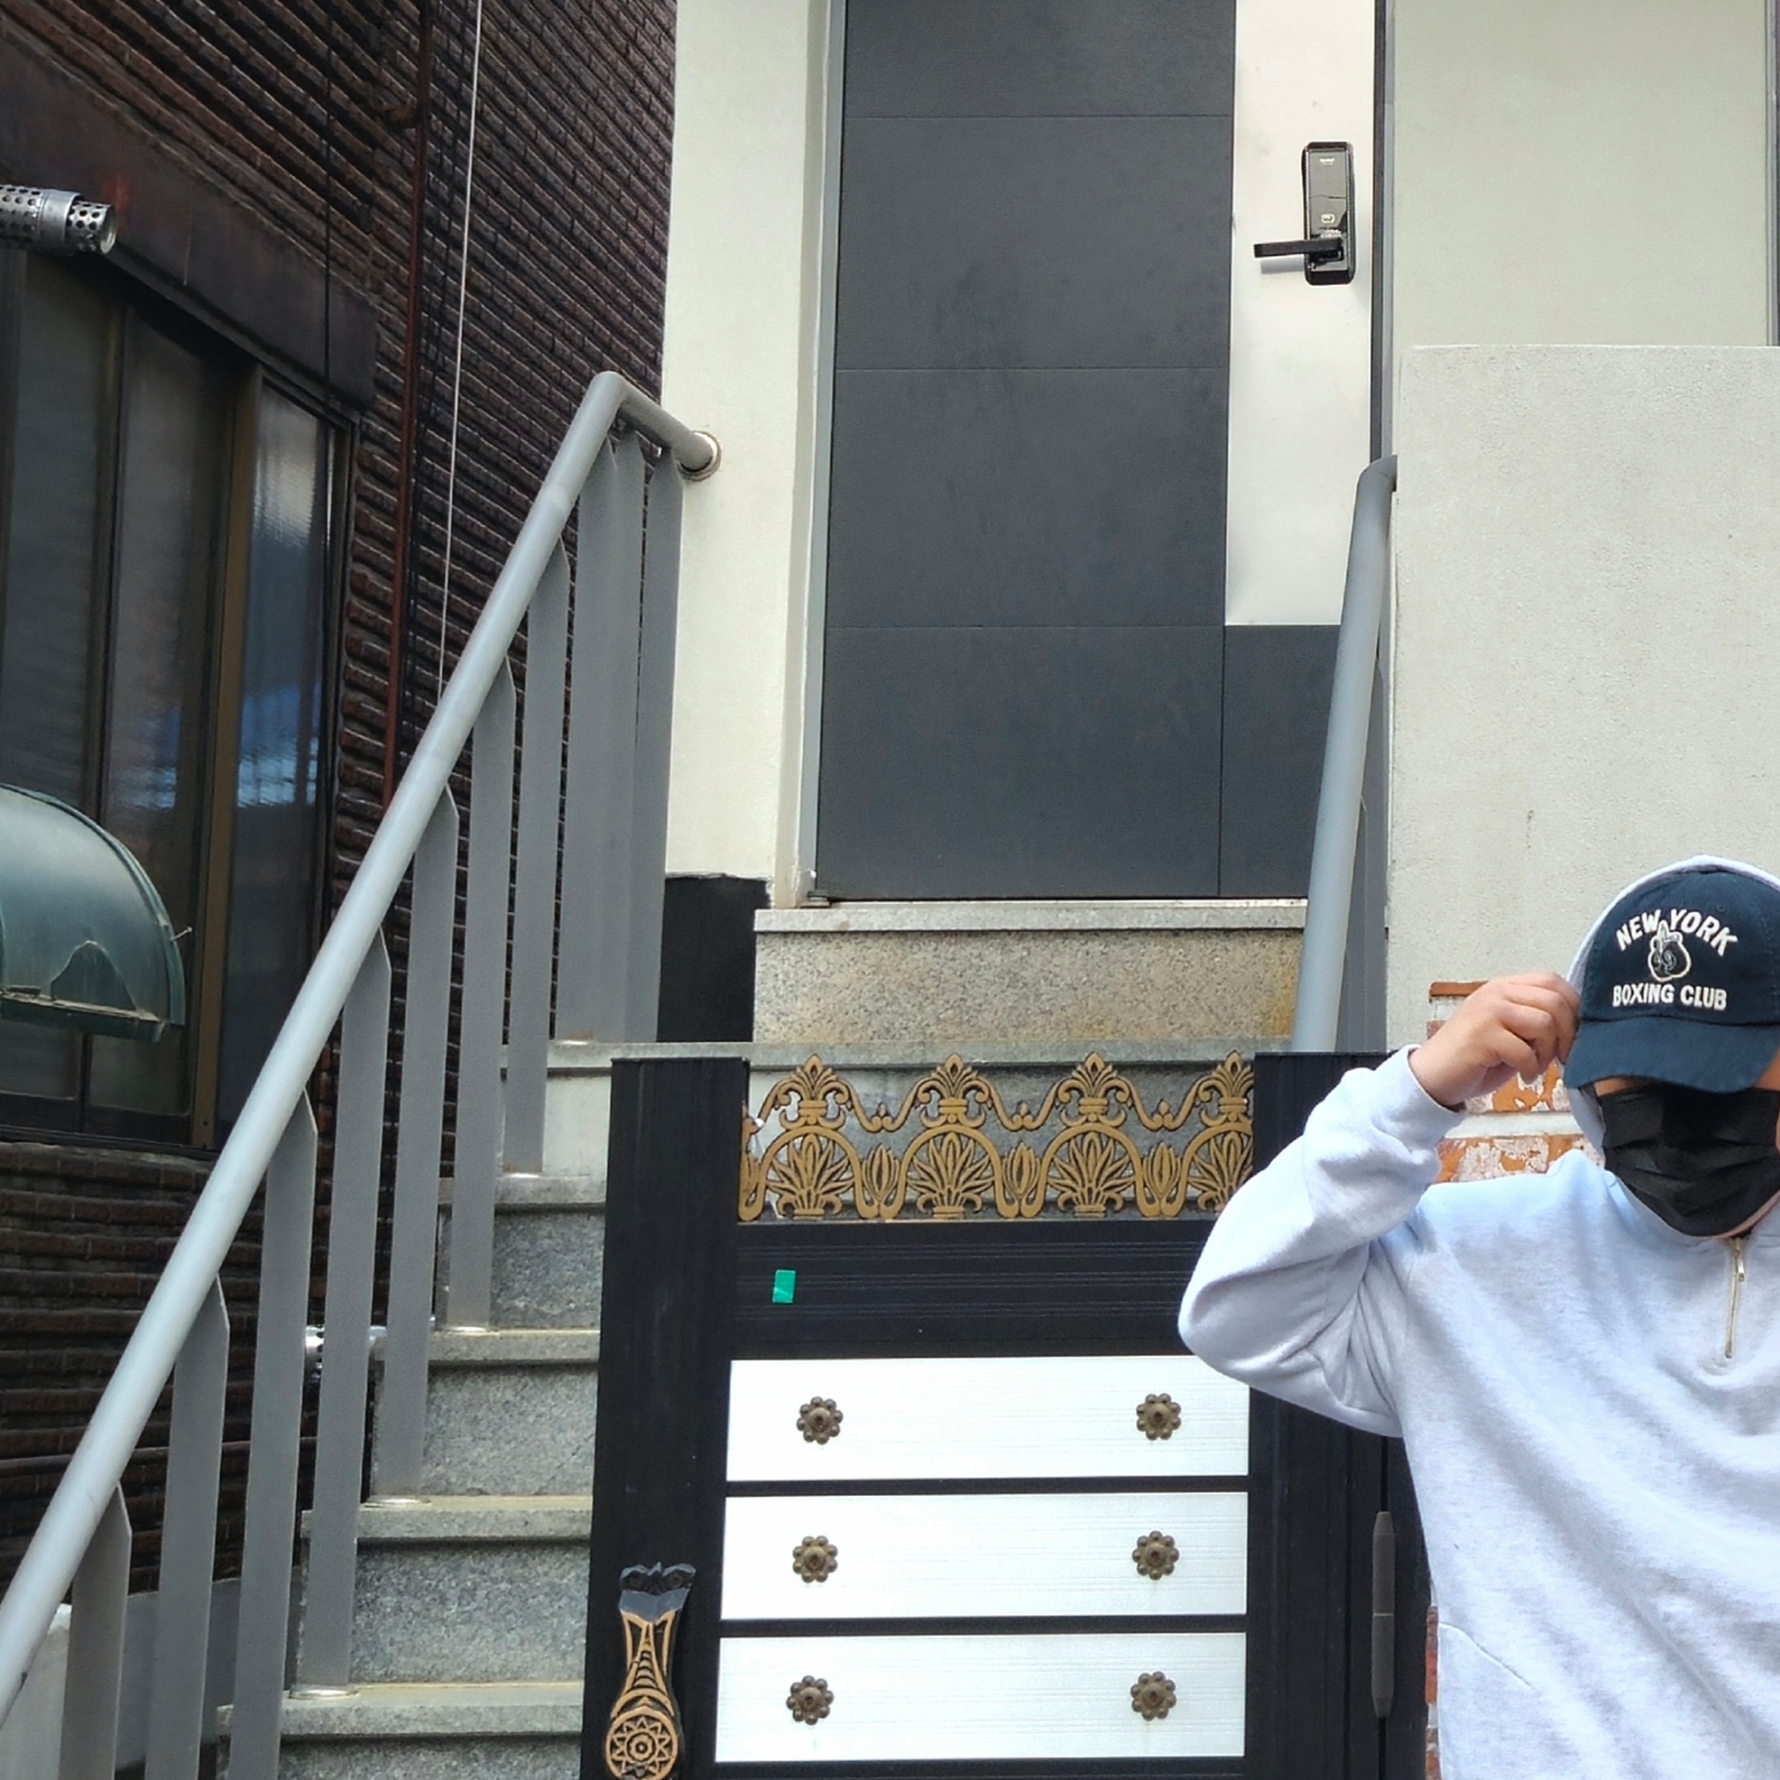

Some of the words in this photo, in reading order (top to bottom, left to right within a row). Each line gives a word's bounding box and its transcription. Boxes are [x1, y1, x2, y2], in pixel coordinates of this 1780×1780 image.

[1616, 909, 1661, 951] NEW
[1670, 908, 1738, 957] YORK
[1612, 983, 1675, 1007] BOXING
[1680, 985, 1727, 1011] CLUB
